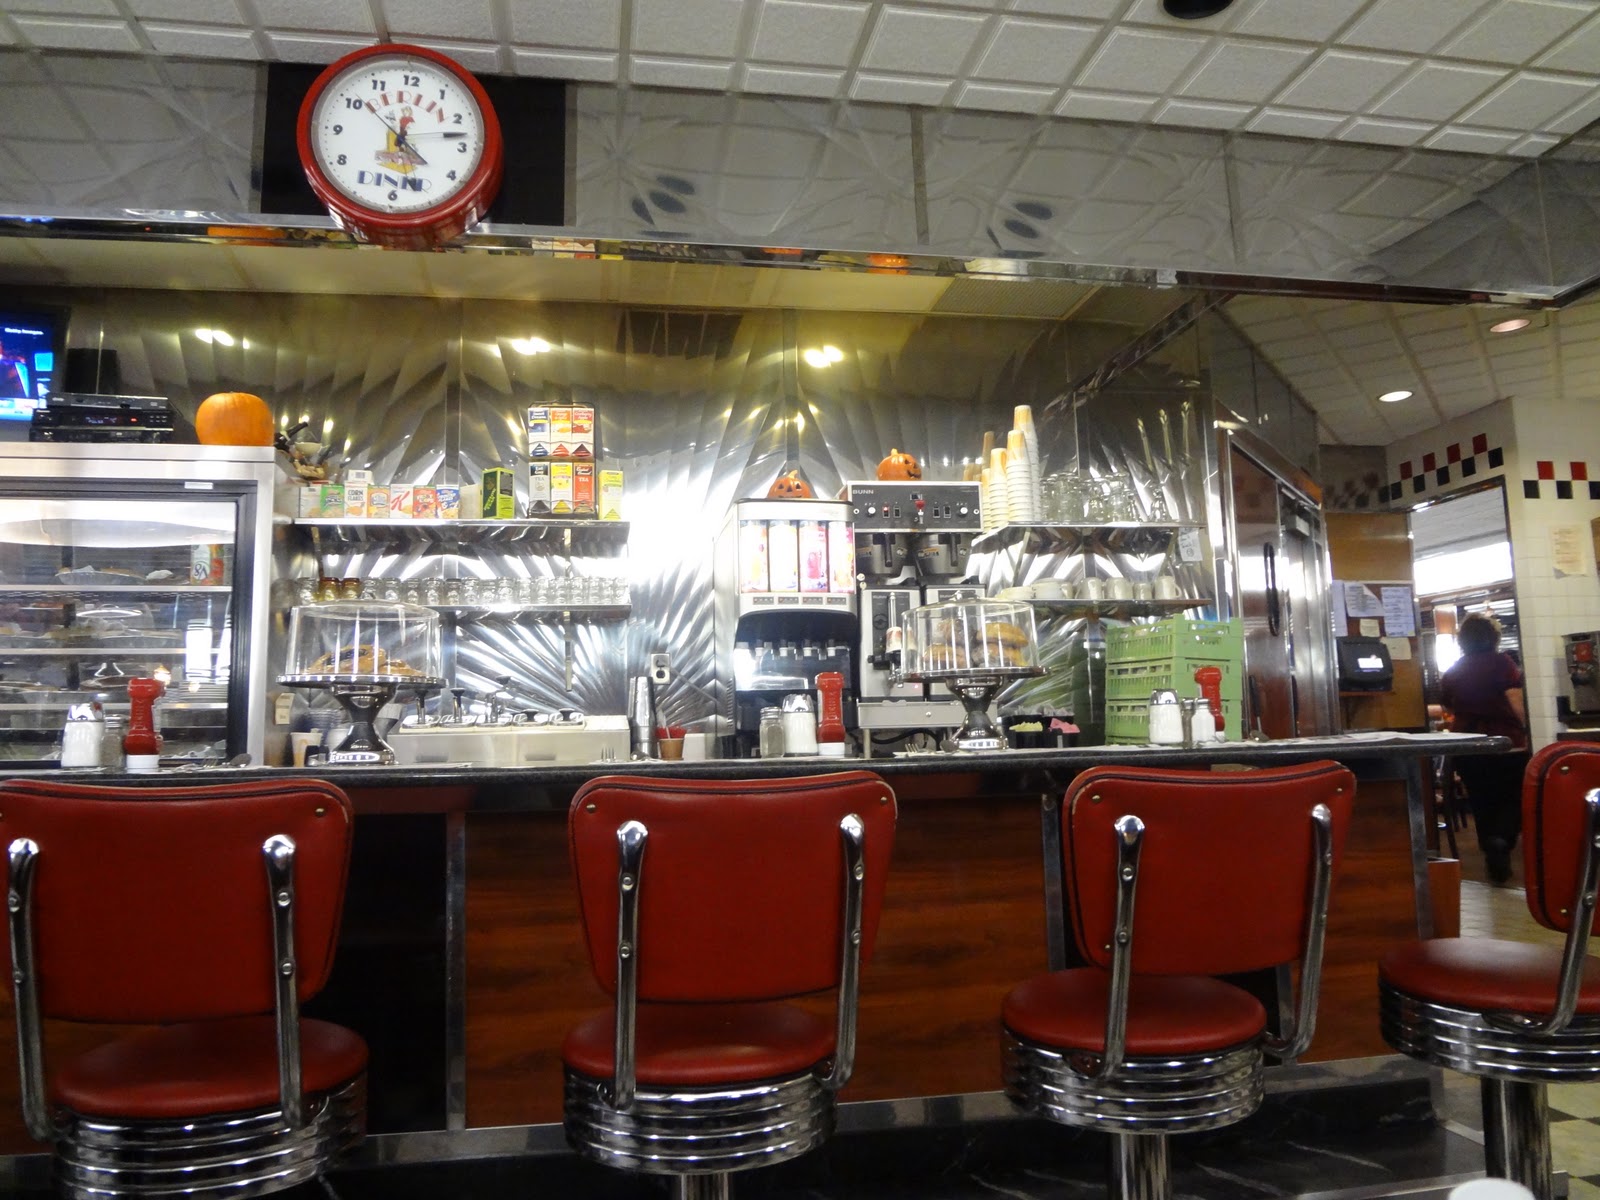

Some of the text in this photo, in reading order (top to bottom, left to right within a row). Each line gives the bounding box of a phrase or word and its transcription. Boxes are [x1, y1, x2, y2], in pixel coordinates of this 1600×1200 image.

[371, 79, 386, 91] 11
[403, 74, 420, 87] 12
[439, 89, 446, 100] 1
[345, 97, 363, 110] 10
[452, 113, 463, 124] 2
[333, 124, 343, 135] 9
[457, 142, 467, 153] 3
[336, 154, 347, 166] 8
[446, 170, 457, 181] 4
[387, 189, 398, 201] 6
